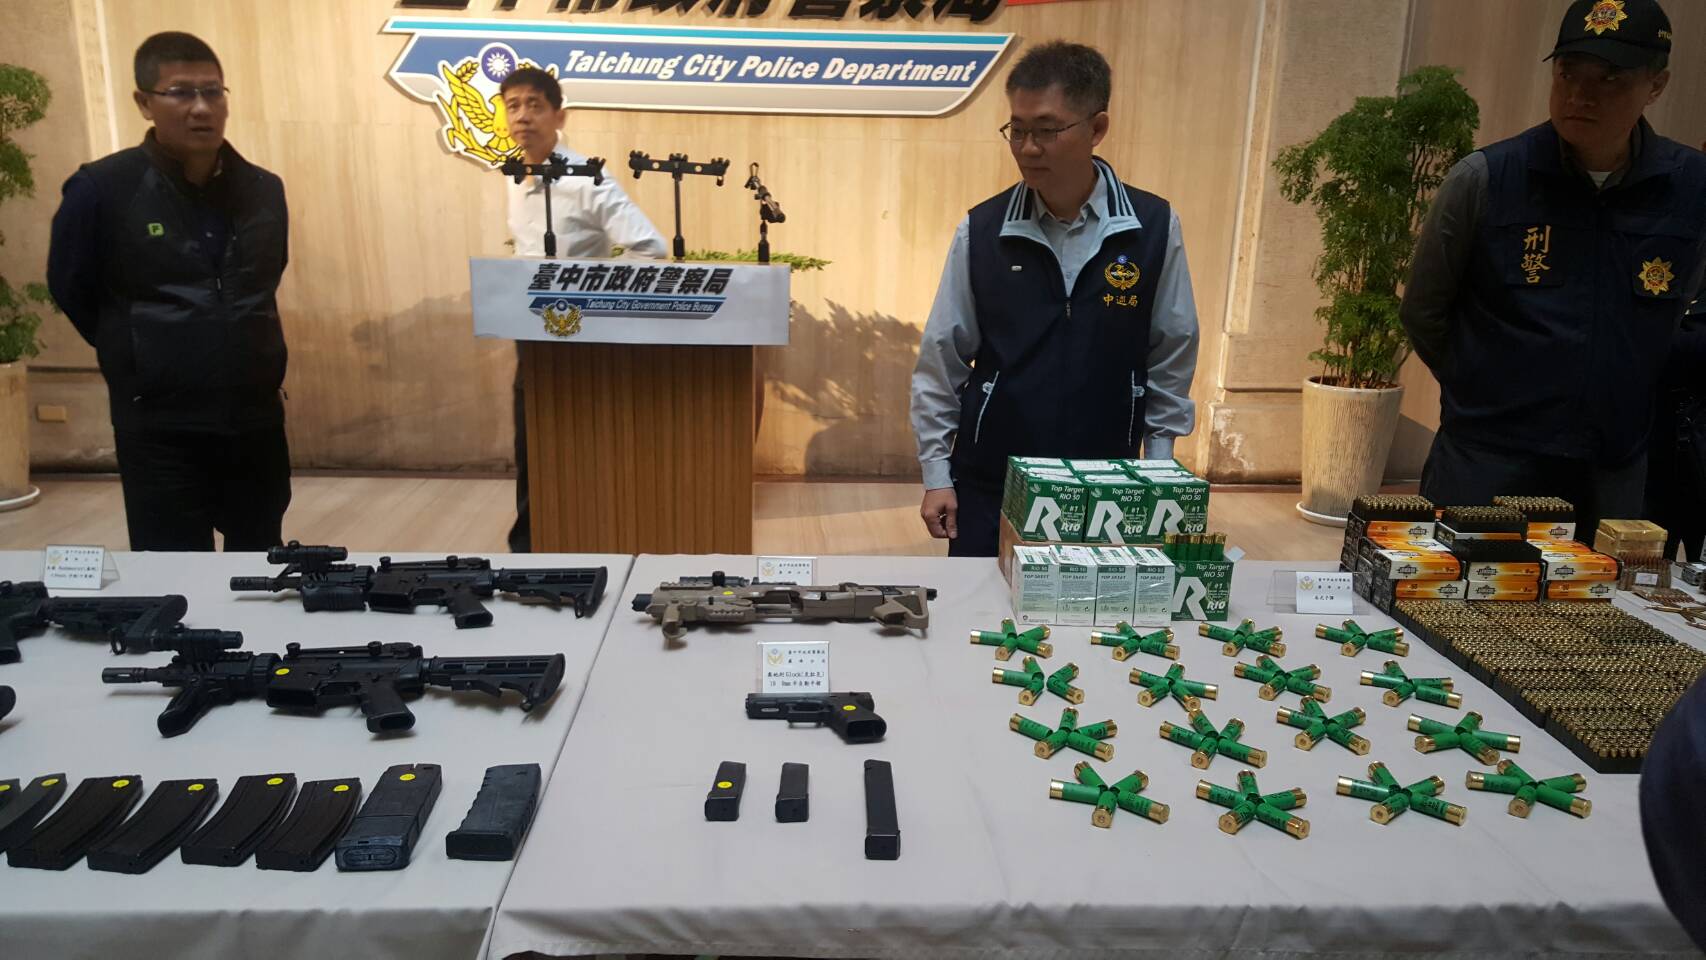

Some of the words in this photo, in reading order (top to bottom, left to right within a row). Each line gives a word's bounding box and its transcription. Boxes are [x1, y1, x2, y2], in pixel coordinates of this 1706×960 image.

[565, 50, 683, 80] Taichung
[683, 53, 738, 81] City
[738, 55, 820, 80] Police
[822, 57, 976, 85] Department
[1520, 225, 1551, 284] 刑警
[528, 262, 734, 295] 臺中市政府警察局
[586, 298, 616, 310] Taichung
[616, 299, 630, 311] City
[631, 299, 672, 311] Government
[672, 301, 692, 311] Police
[692, 302, 715, 312] Bureau
[1064, 486, 1084, 494] Target
[1209, 563, 1230, 572] Target
